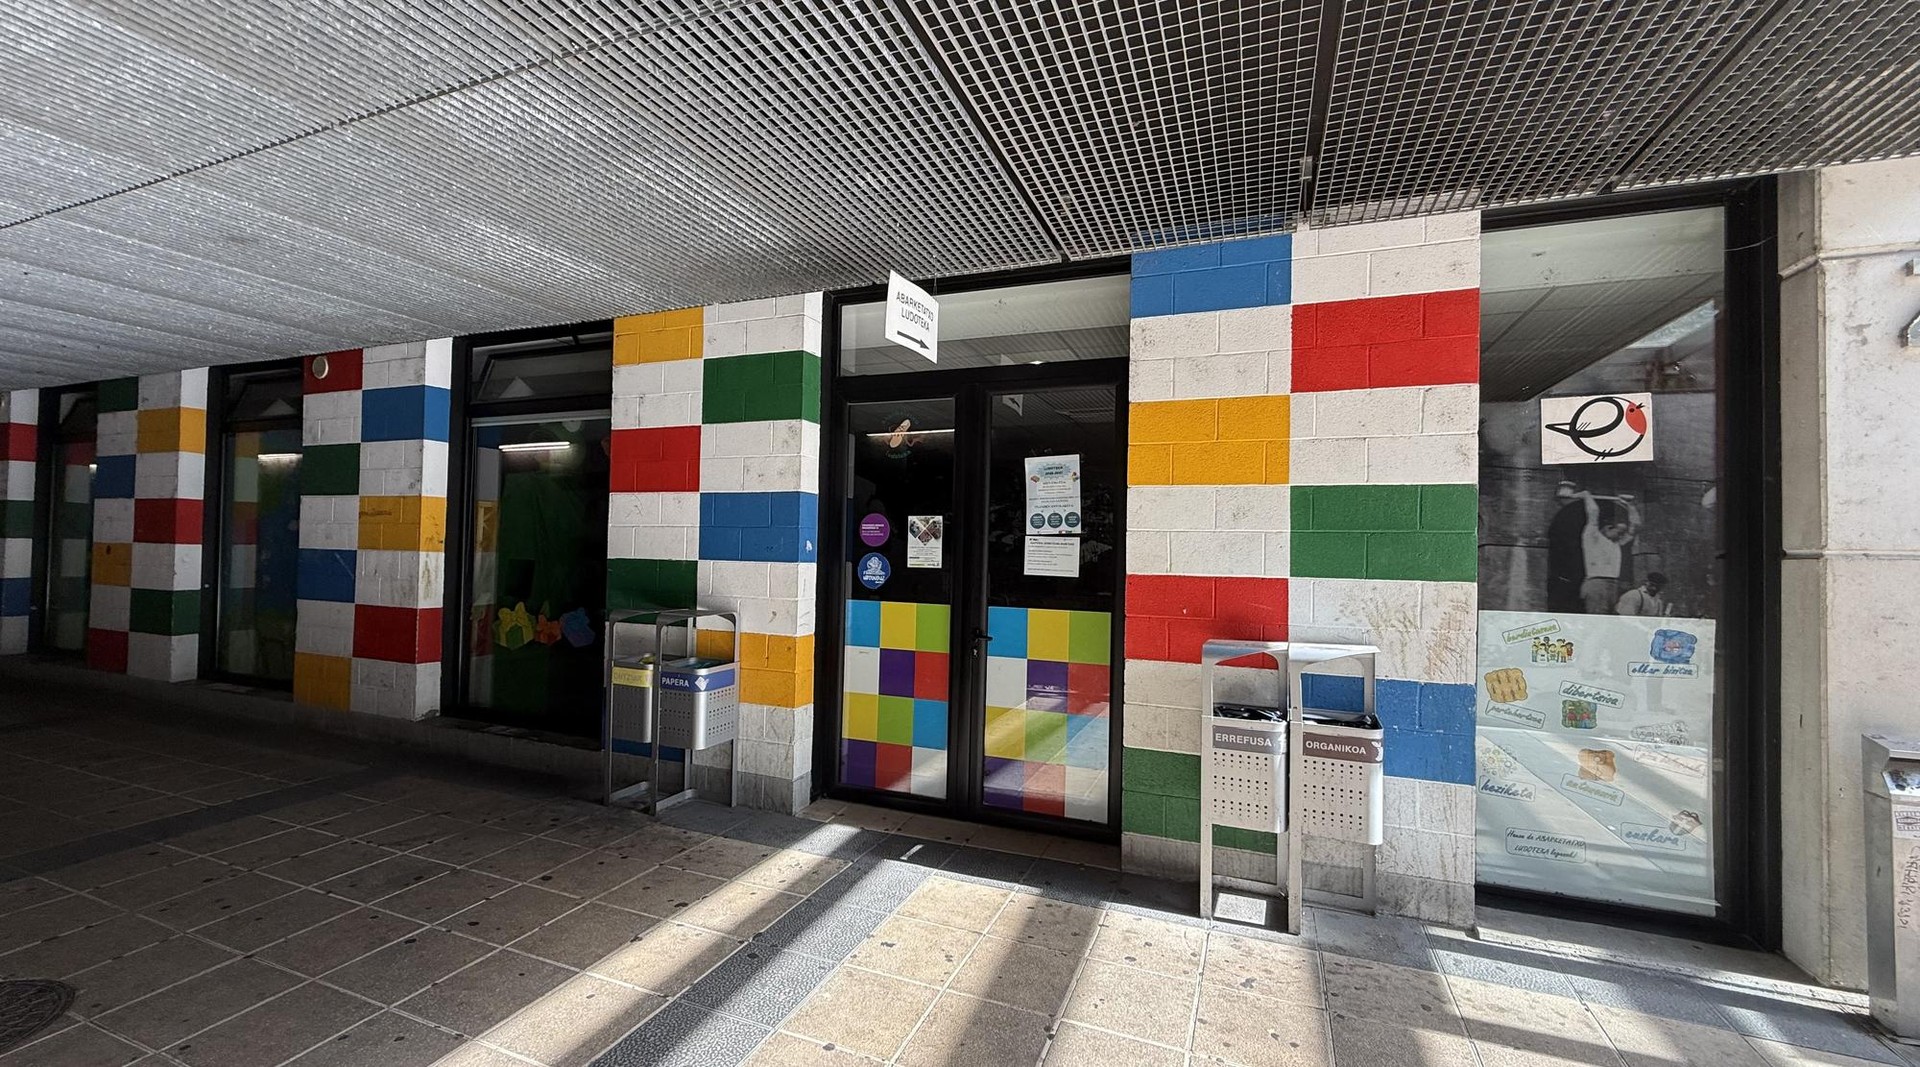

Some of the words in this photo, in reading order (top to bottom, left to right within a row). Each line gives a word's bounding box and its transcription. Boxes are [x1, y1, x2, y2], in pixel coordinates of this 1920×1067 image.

[901, 306, 930, 332] LUDOTEKA
[661, 677, 690, 687] PAPERA
[1215, 733, 1272, 747] ERREFUSA
[1305, 740, 1367, 755] ORGANIKOA
